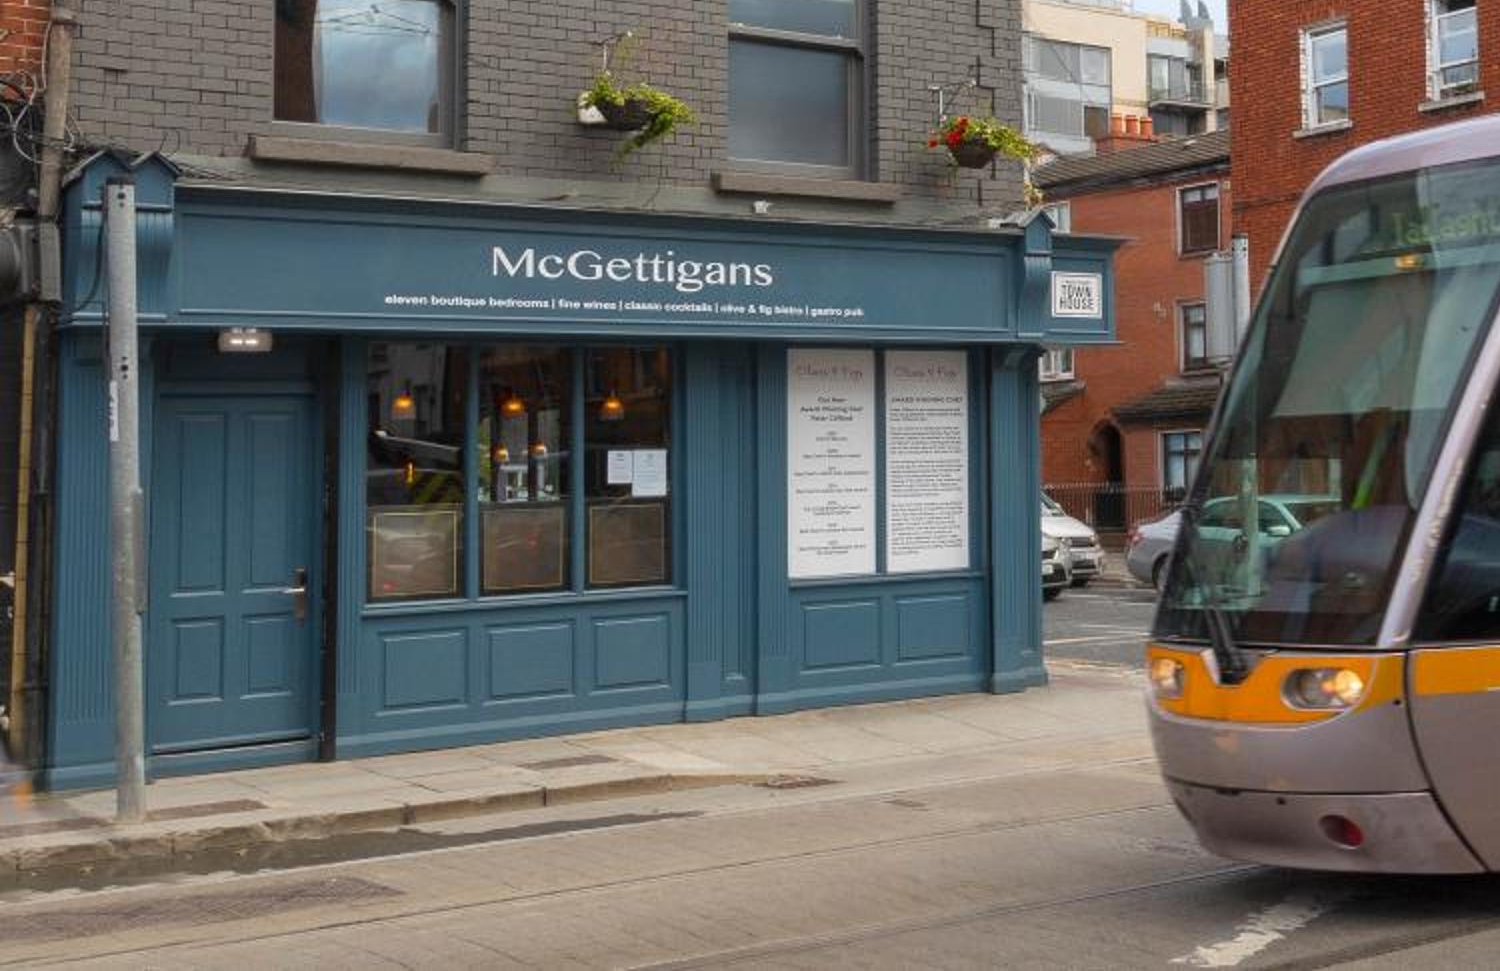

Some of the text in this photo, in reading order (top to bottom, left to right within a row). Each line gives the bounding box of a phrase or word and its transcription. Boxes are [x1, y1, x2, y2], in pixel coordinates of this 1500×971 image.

[492, 246, 773, 293] McGettigans
[1061, 284, 1091, 299] TOWN
[385, 295, 428, 306] eleven
[431, 295, 486, 308] boutique
[489, 296, 549, 309] bedrooms
[558, 298, 580, 310] fine
[583, 299, 616, 310] wines
[624, 300, 662, 311] classic
[664, 301, 713, 313] cocktails
[747, 304, 757, 314] &
[811, 307, 841, 317] gastro
[1060, 297, 1095, 310] HOUSE
